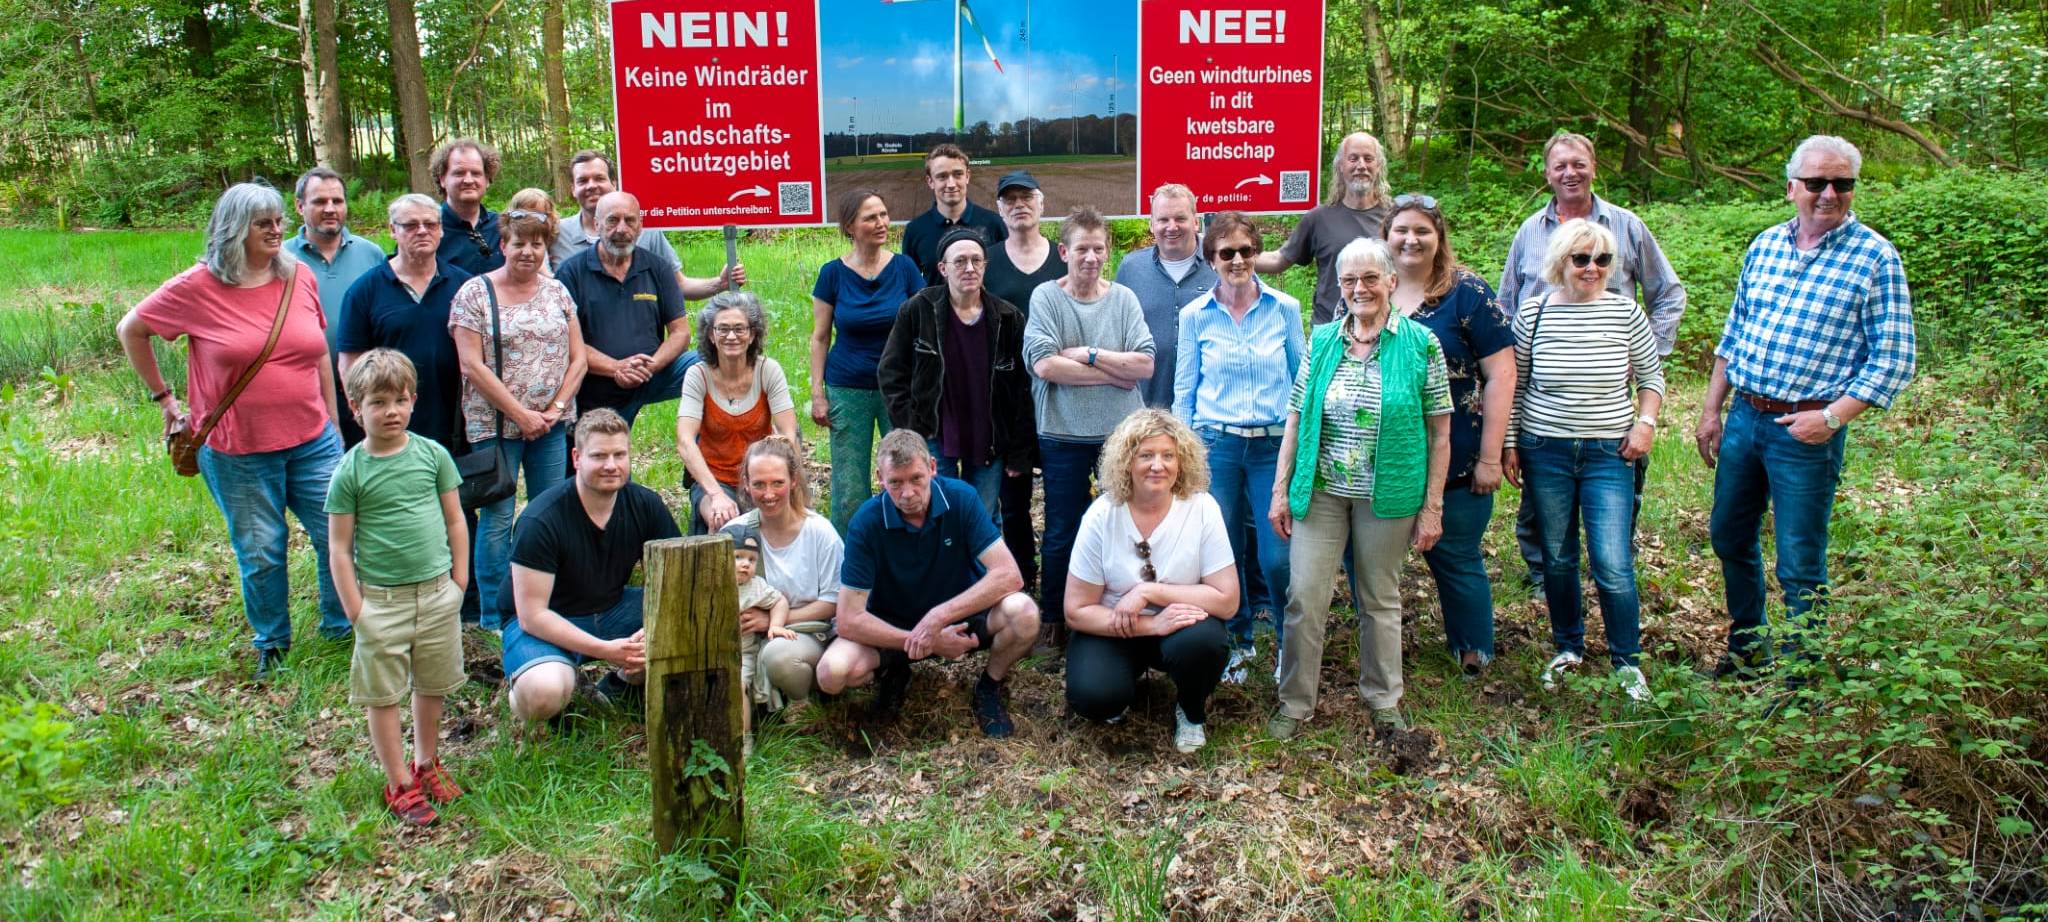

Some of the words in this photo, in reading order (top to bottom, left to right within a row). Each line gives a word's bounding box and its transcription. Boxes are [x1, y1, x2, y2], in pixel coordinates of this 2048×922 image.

[640, 11, 789, 48] NEIN!
[1179, 9, 1286, 44] NEE!
[625, 66, 688, 88] Keine
[694, 64, 808, 87] Windräder
[1150, 66, 1195, 84] Geen
[1200, 66, 1312, 84] windturbines
[705, 98, 731, 119] im
[1210, 91, 1226, 109] in
[1231, 91, 1253, 109] dit
[648, 123, 791, 147] Landschafts-
[1186, 117, 1275, 135] kwetsbare
[1186, 142, 1275, 163] landschap
[650, 151, 791, 177] schutzgebiet
[1202, 194, 1214, 203] de
[1217, 193, 1252, 204] petitie:
[650, 208, 665, 217] die
[666, 206, 700, 216] Petition
[703, 205, 773, 216] unterschreiben:
